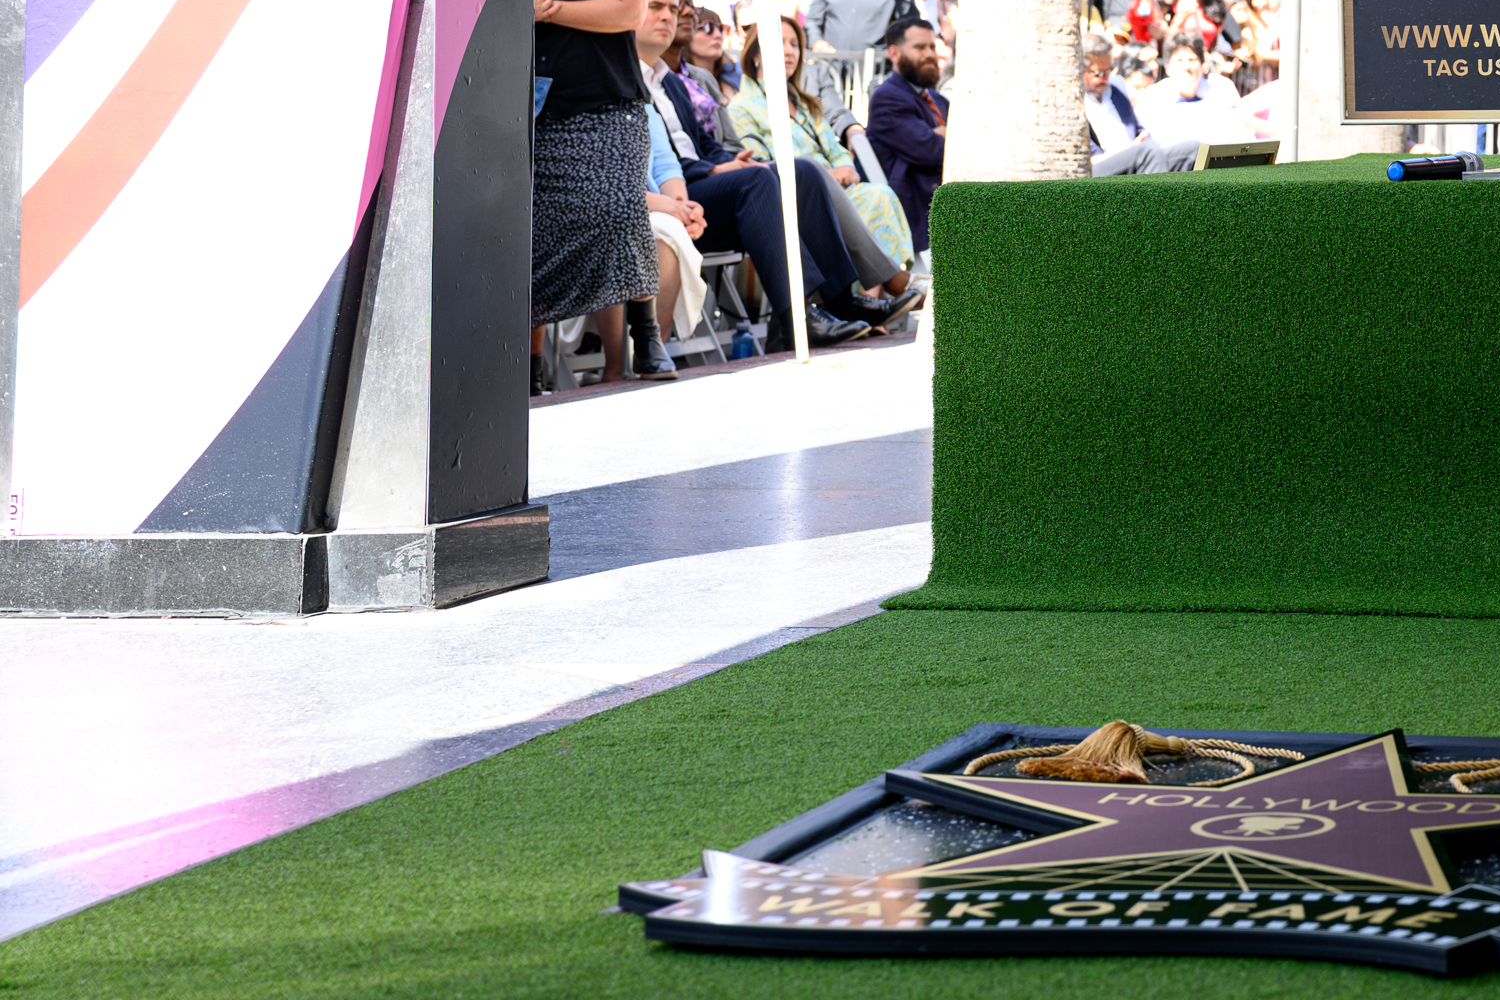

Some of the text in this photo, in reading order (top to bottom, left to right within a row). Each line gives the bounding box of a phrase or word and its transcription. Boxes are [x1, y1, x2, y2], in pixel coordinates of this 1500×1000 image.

[1423, 59, 1469, 77] TAG
[758, 895, 1459, 928] WALK OF FAME
